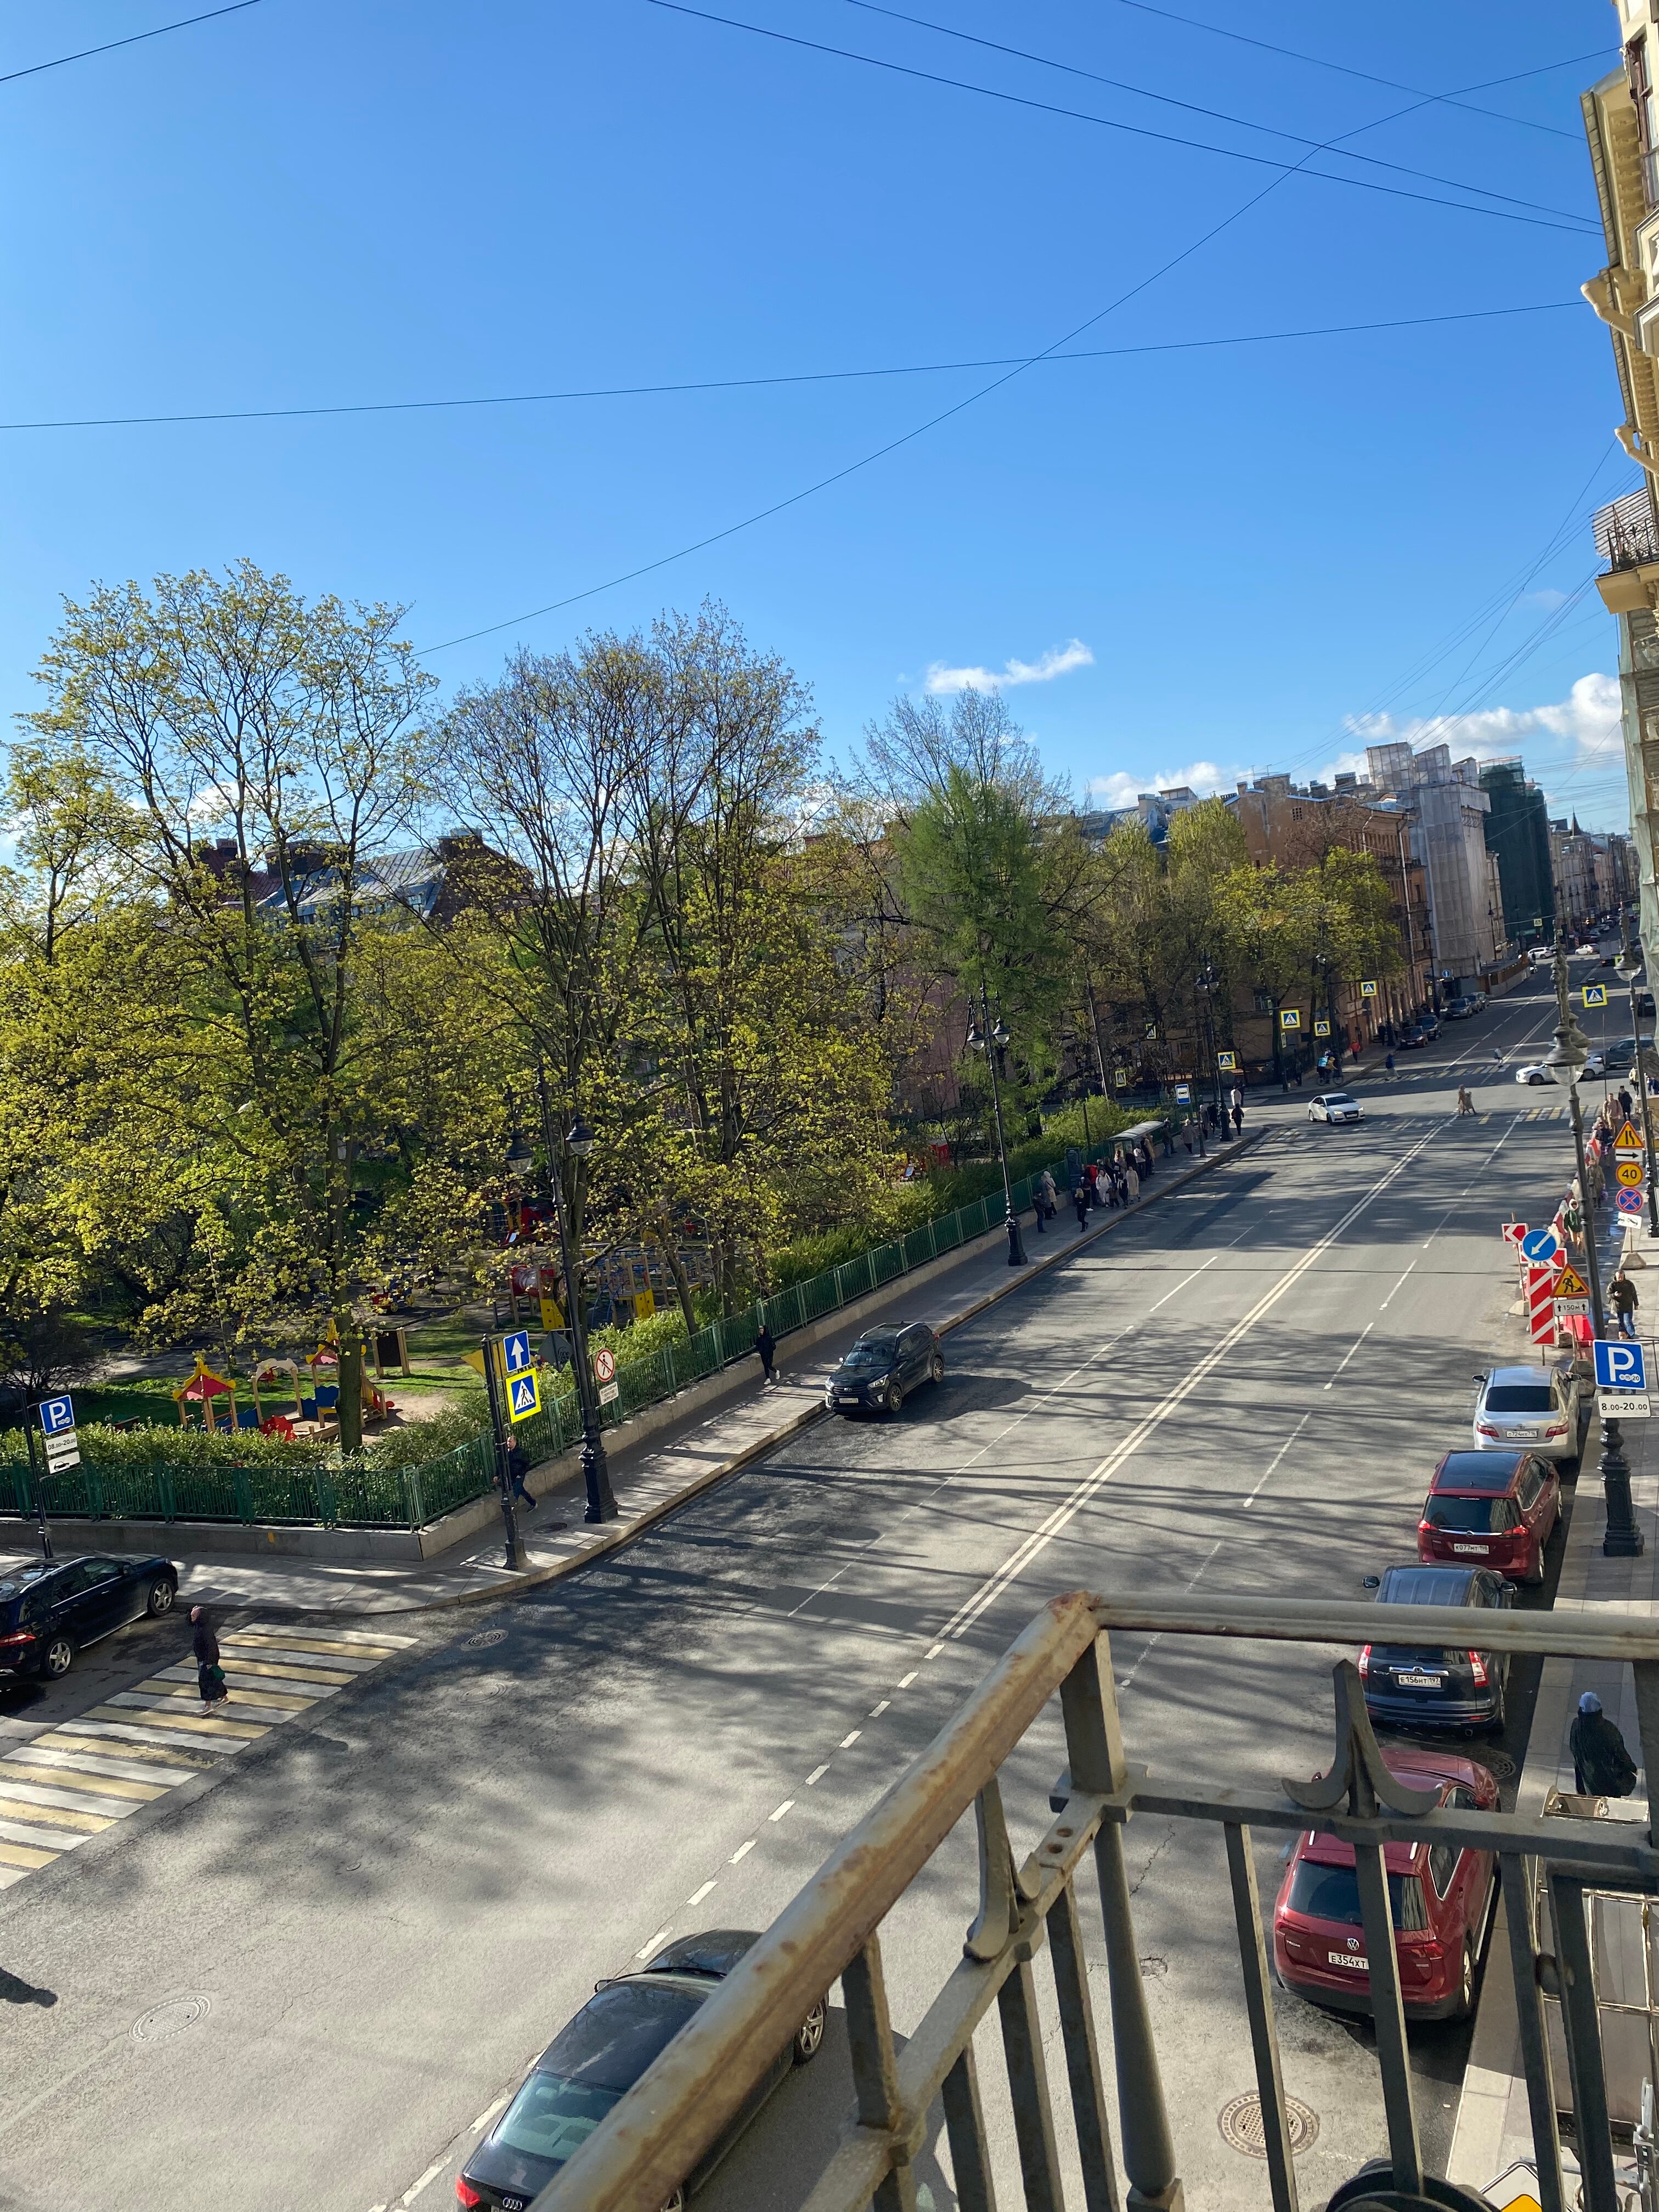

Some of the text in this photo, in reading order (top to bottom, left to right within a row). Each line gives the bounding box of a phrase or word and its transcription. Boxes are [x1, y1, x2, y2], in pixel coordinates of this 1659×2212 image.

[1622, 1169, 1638, 1179] 40
[1607, 1346, 1634, 1382] P
[48, 1402, 66, 1429] P
